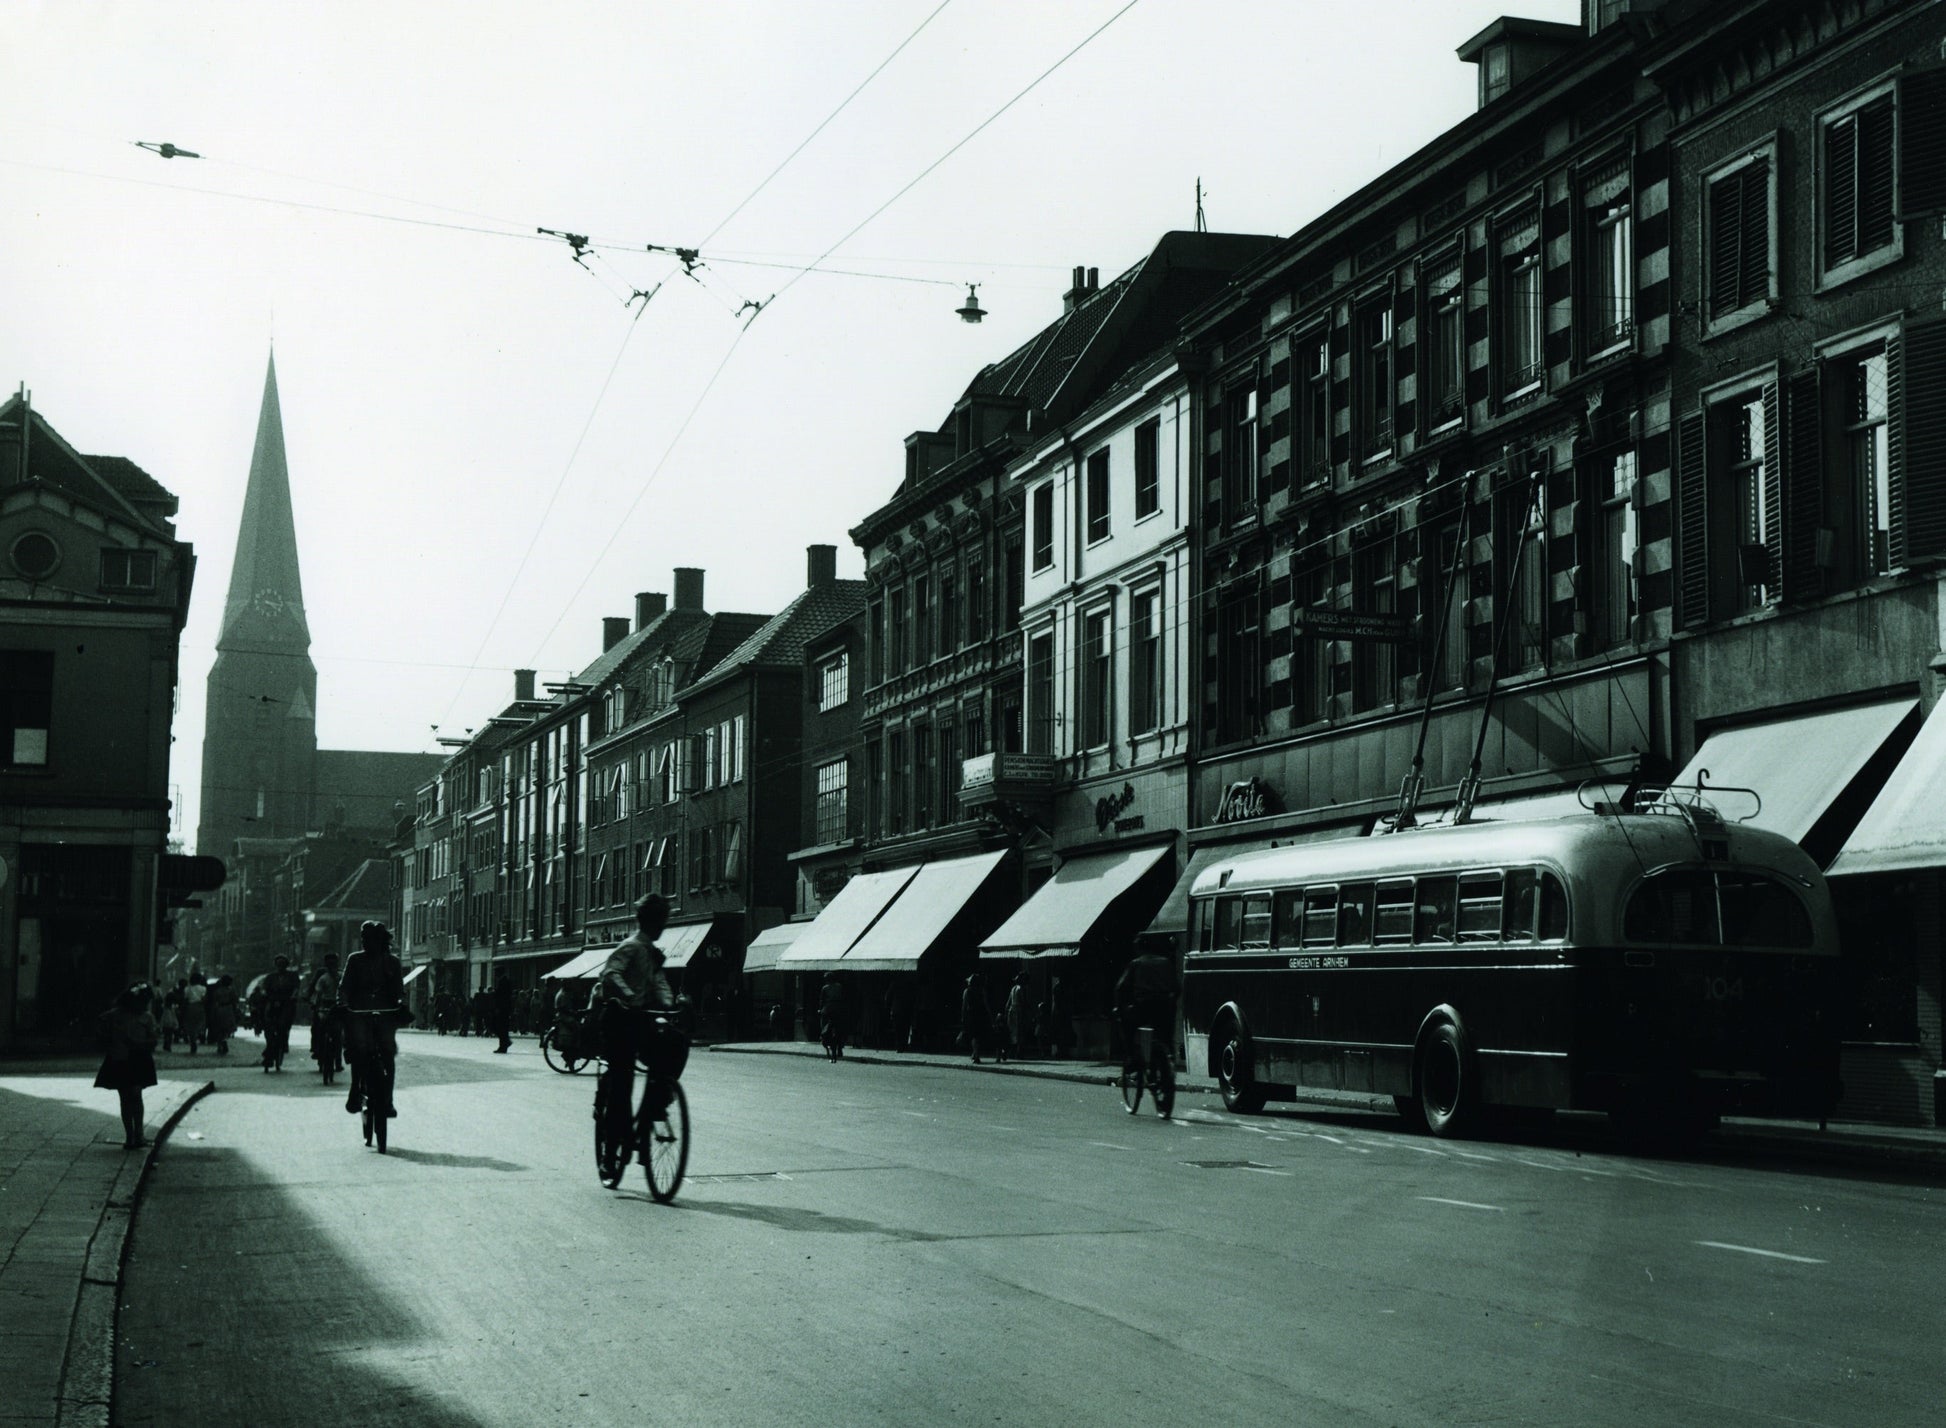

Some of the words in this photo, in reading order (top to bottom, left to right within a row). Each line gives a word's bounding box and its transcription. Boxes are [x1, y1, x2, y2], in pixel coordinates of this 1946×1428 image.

[1305, 611, 1339, 625] KAMERS
[1288, 957, 1321, 969] GEMEENTE
[1322, 956, 1349, 968] ARNHEM
